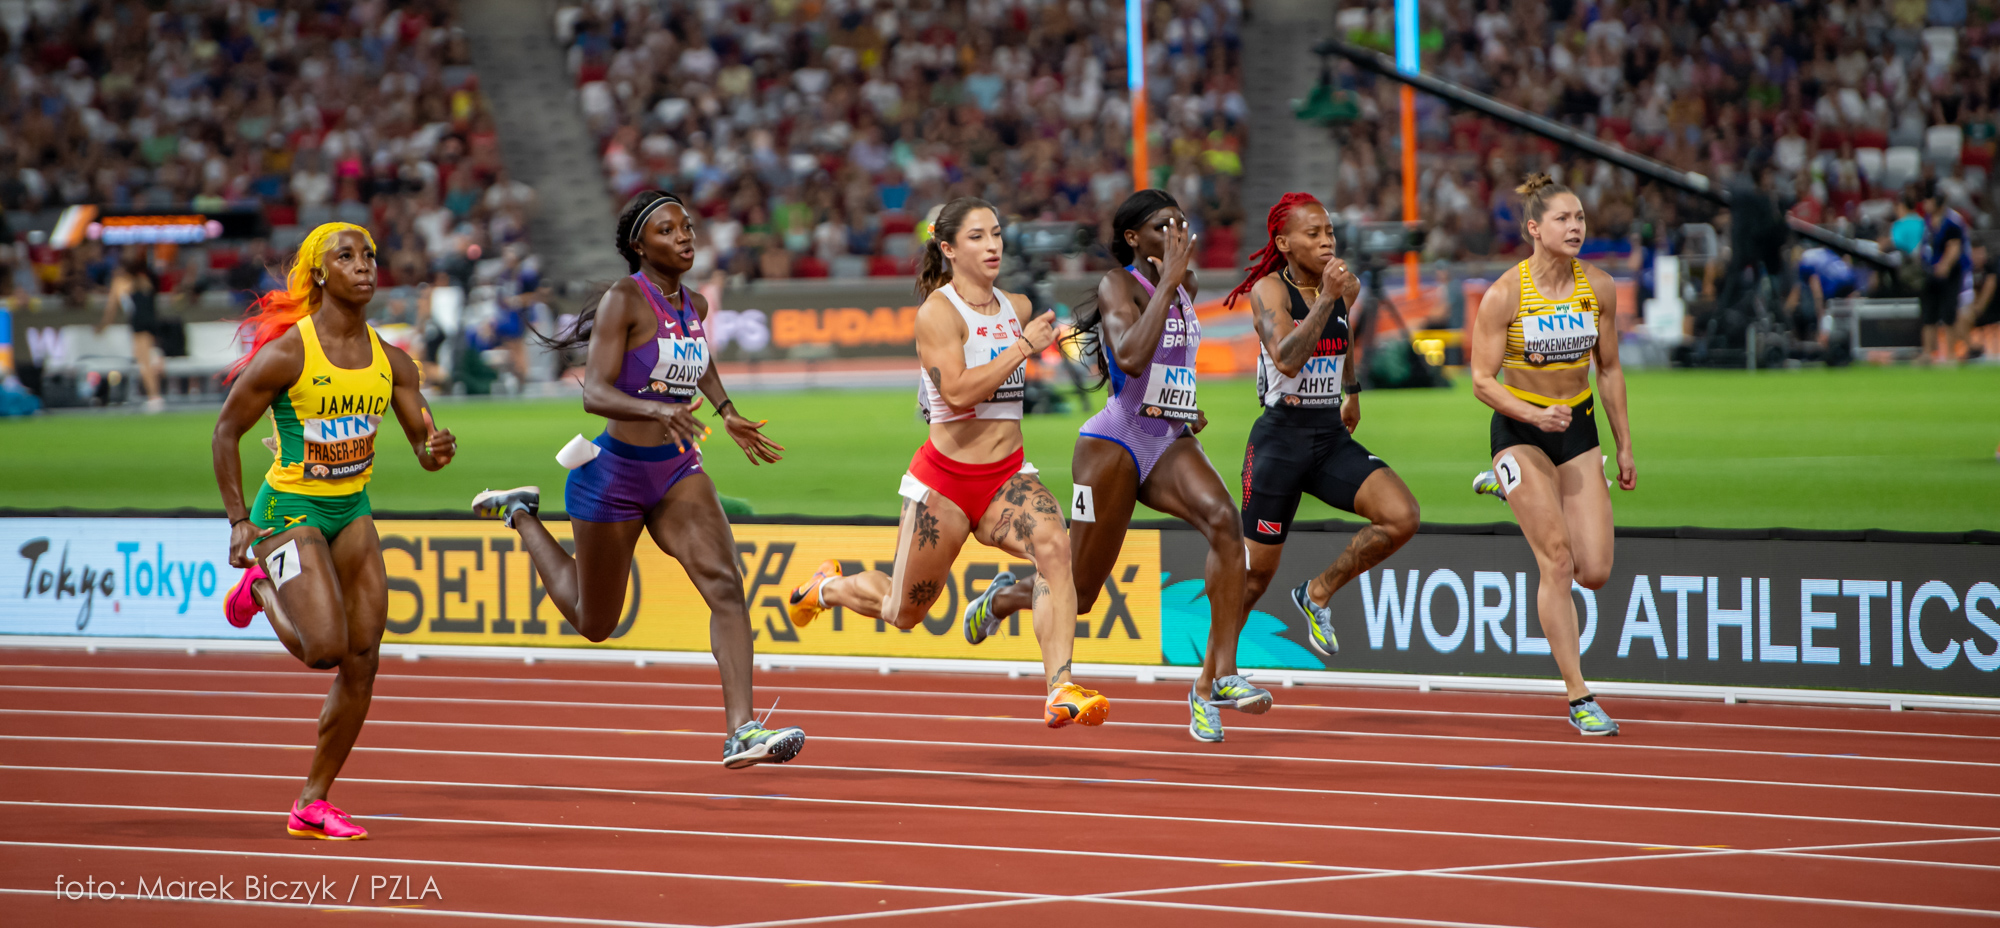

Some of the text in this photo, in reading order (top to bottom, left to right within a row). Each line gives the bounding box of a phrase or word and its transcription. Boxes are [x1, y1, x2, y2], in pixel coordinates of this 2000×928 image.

[1537, 312, 1585, 332] NTN
[673, 341, 702, 362] NTN
[1316, 337, 1342, 351] NIDAD
[1527, 335, 1595, 352] LÜCKENKEMPER
[1546, 351, 1583, 361] BUDAPEST
[665, 364, 703, 382] DAVIS
[1164, 366, 1196, 386] NTN
[996, 390, 1024, 399] BUDAPES
[1297, 377, 1334, 393] AHYE
[1164, 410, 1198, 420] BUDAPES
[320, 415, 370, 440] NTN
[1501, 462, 1516, 485] 2
[1075, 490, 1086, 515] 4
[272, 549, 286, 579] 7
[1359, 568, 2000, 672] WORLD ATHLETICS
